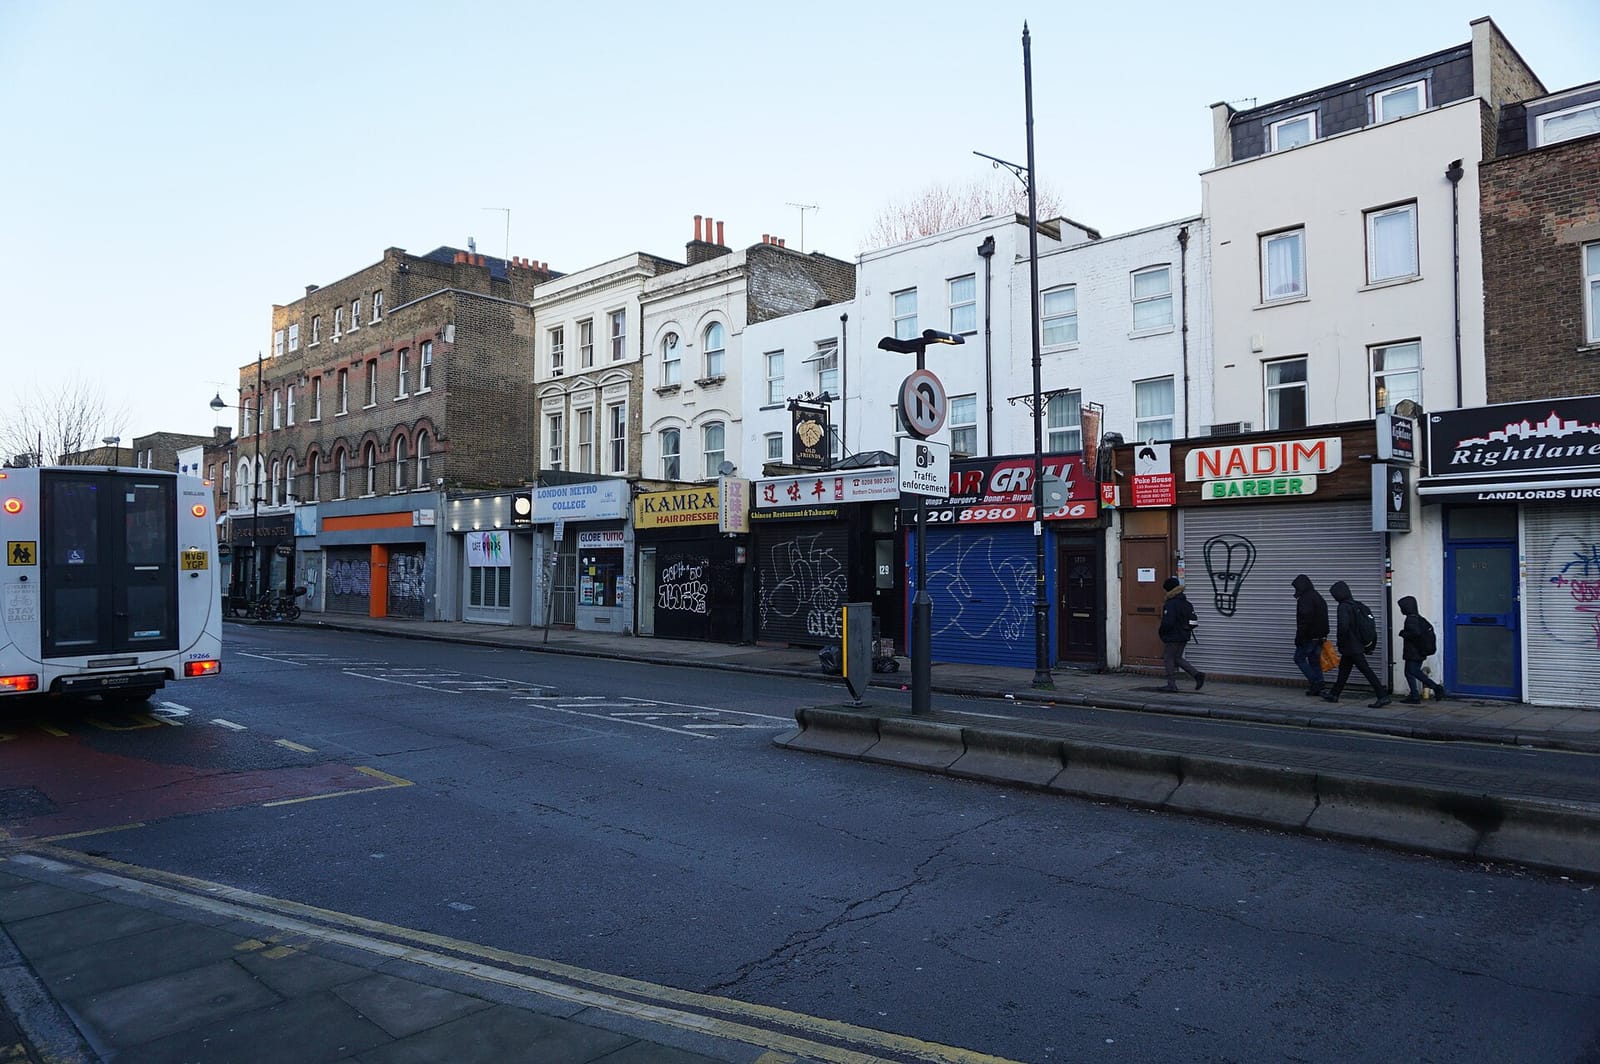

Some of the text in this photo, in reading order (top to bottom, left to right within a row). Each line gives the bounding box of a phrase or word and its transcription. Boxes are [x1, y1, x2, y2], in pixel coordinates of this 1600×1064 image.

[1196, 440, 1328, 479] NADIM
[1449, 442, 1600, 466] Rightlane
[913, 471, 937, 482] Traffic
[537, 485, 598, 499] LONDON METRO
[902, 481, 948, 494] enforcement
[1212, 478, 1304, 497] BARBER
[949, 496, 977, 505] Burgers
[1478, 489, 1567, 500] LANDLORDS
[552, 500, 587, 511] COLLEGE
[644, 492, 719, 513] KAMRA
[656, 511, 719, 524] HAIRDRESSER
[751, 511, 772, 519] Chinese
[772, 510, 803, 518] Restaurant
[808, 509, 838, 518] Takeaway
[959, 508, 1018, 521] 8980
[1026, 504, 1086, 519] 106
[580, 532, 601, 542] GLOBE
[186, 560, 204, 569] YGP
[189, 653, 210, 661] 19266
